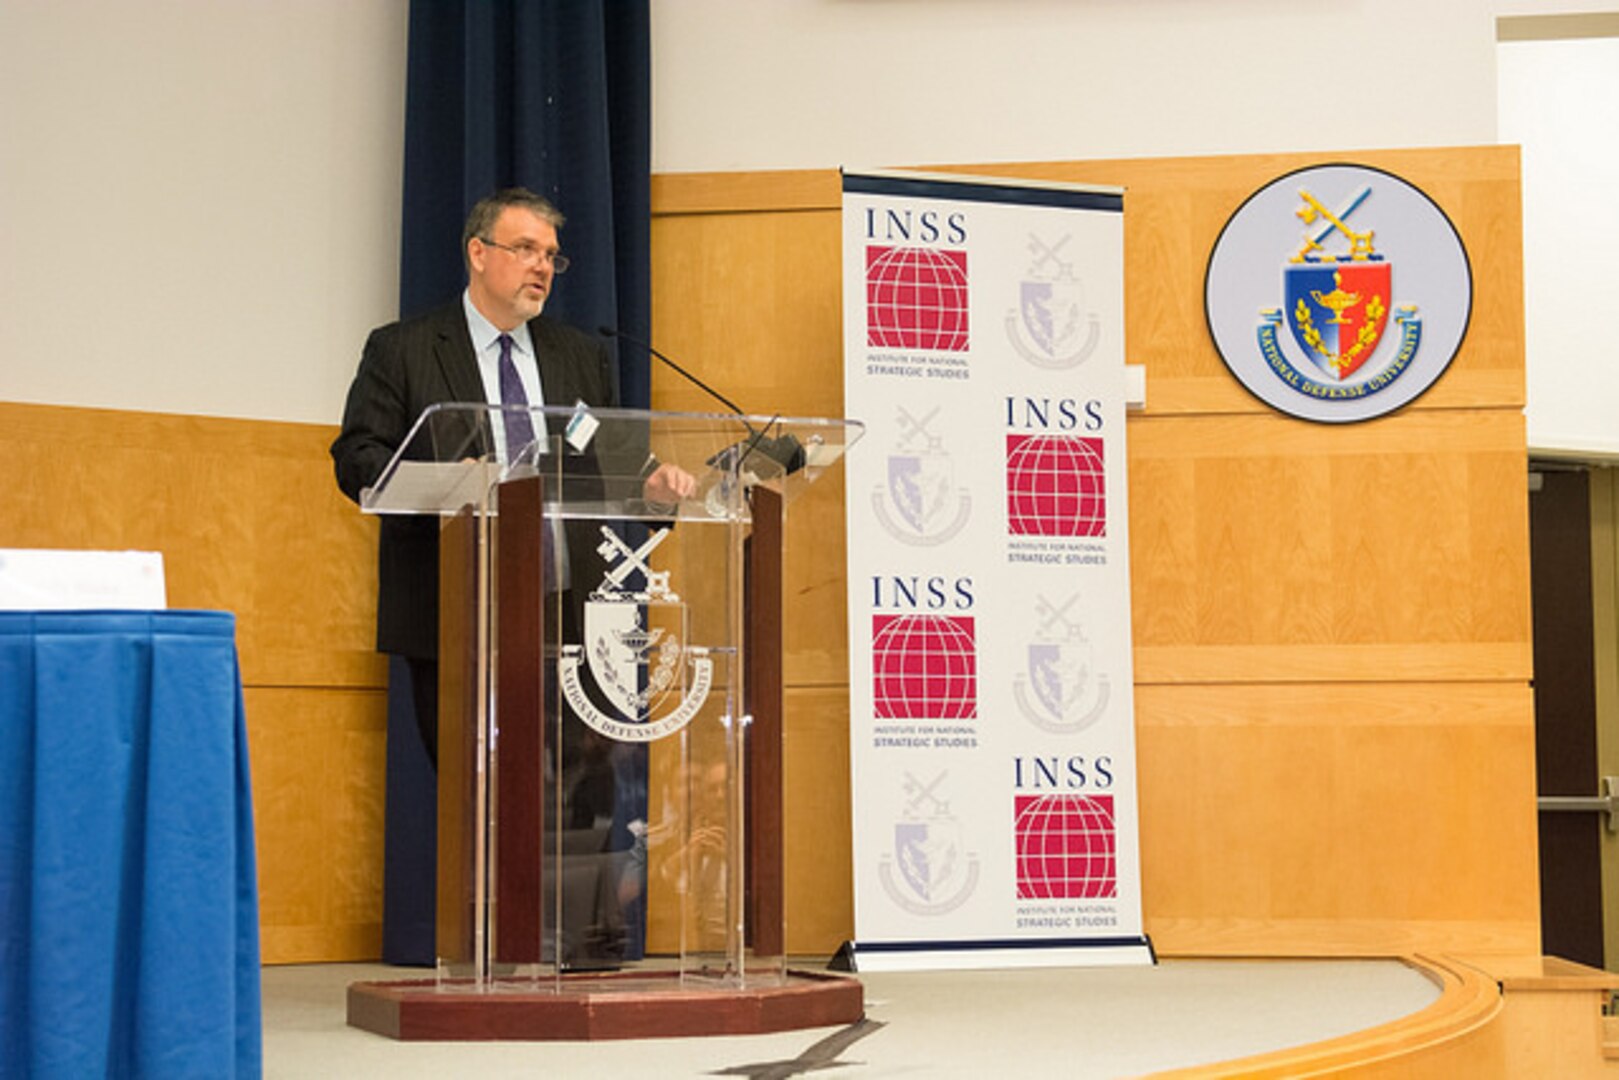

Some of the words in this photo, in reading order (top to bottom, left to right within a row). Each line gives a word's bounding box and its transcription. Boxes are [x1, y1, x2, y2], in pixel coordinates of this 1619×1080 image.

[866, 208, 967, 244] INSS
[867, 365, 922, 377] STRATEGIC
[926, 368, 970, 380] STUDIES
[1260, 329, 1299, 387] NATIONAL
[1301, 380, 1367, 399] DEFENSE
[1369, 323, 1418, 391] UNIVERSITY
[1006, 397, 1103, 431] INSS
[1008, 553, 1061, 564] STRATEGIC
[1065, 554, 1106, 565] STUDIES
[872, 576, 974, 610] INSS
[563, 667, 598, 726] NATIONAL
[601, 721, 657, 738] DEFENSE
[663, 664, 709, 731] UNIVERSITY
[874, 737, 930, 748] STRATEGIC
[934, 737, 977, 748] STUDIES
[1015, 756, 1113, 789] INSS
[1017, 917, 1072, 929] STRATEGIC
[1075, 916, 1117, 927] STUDIES
